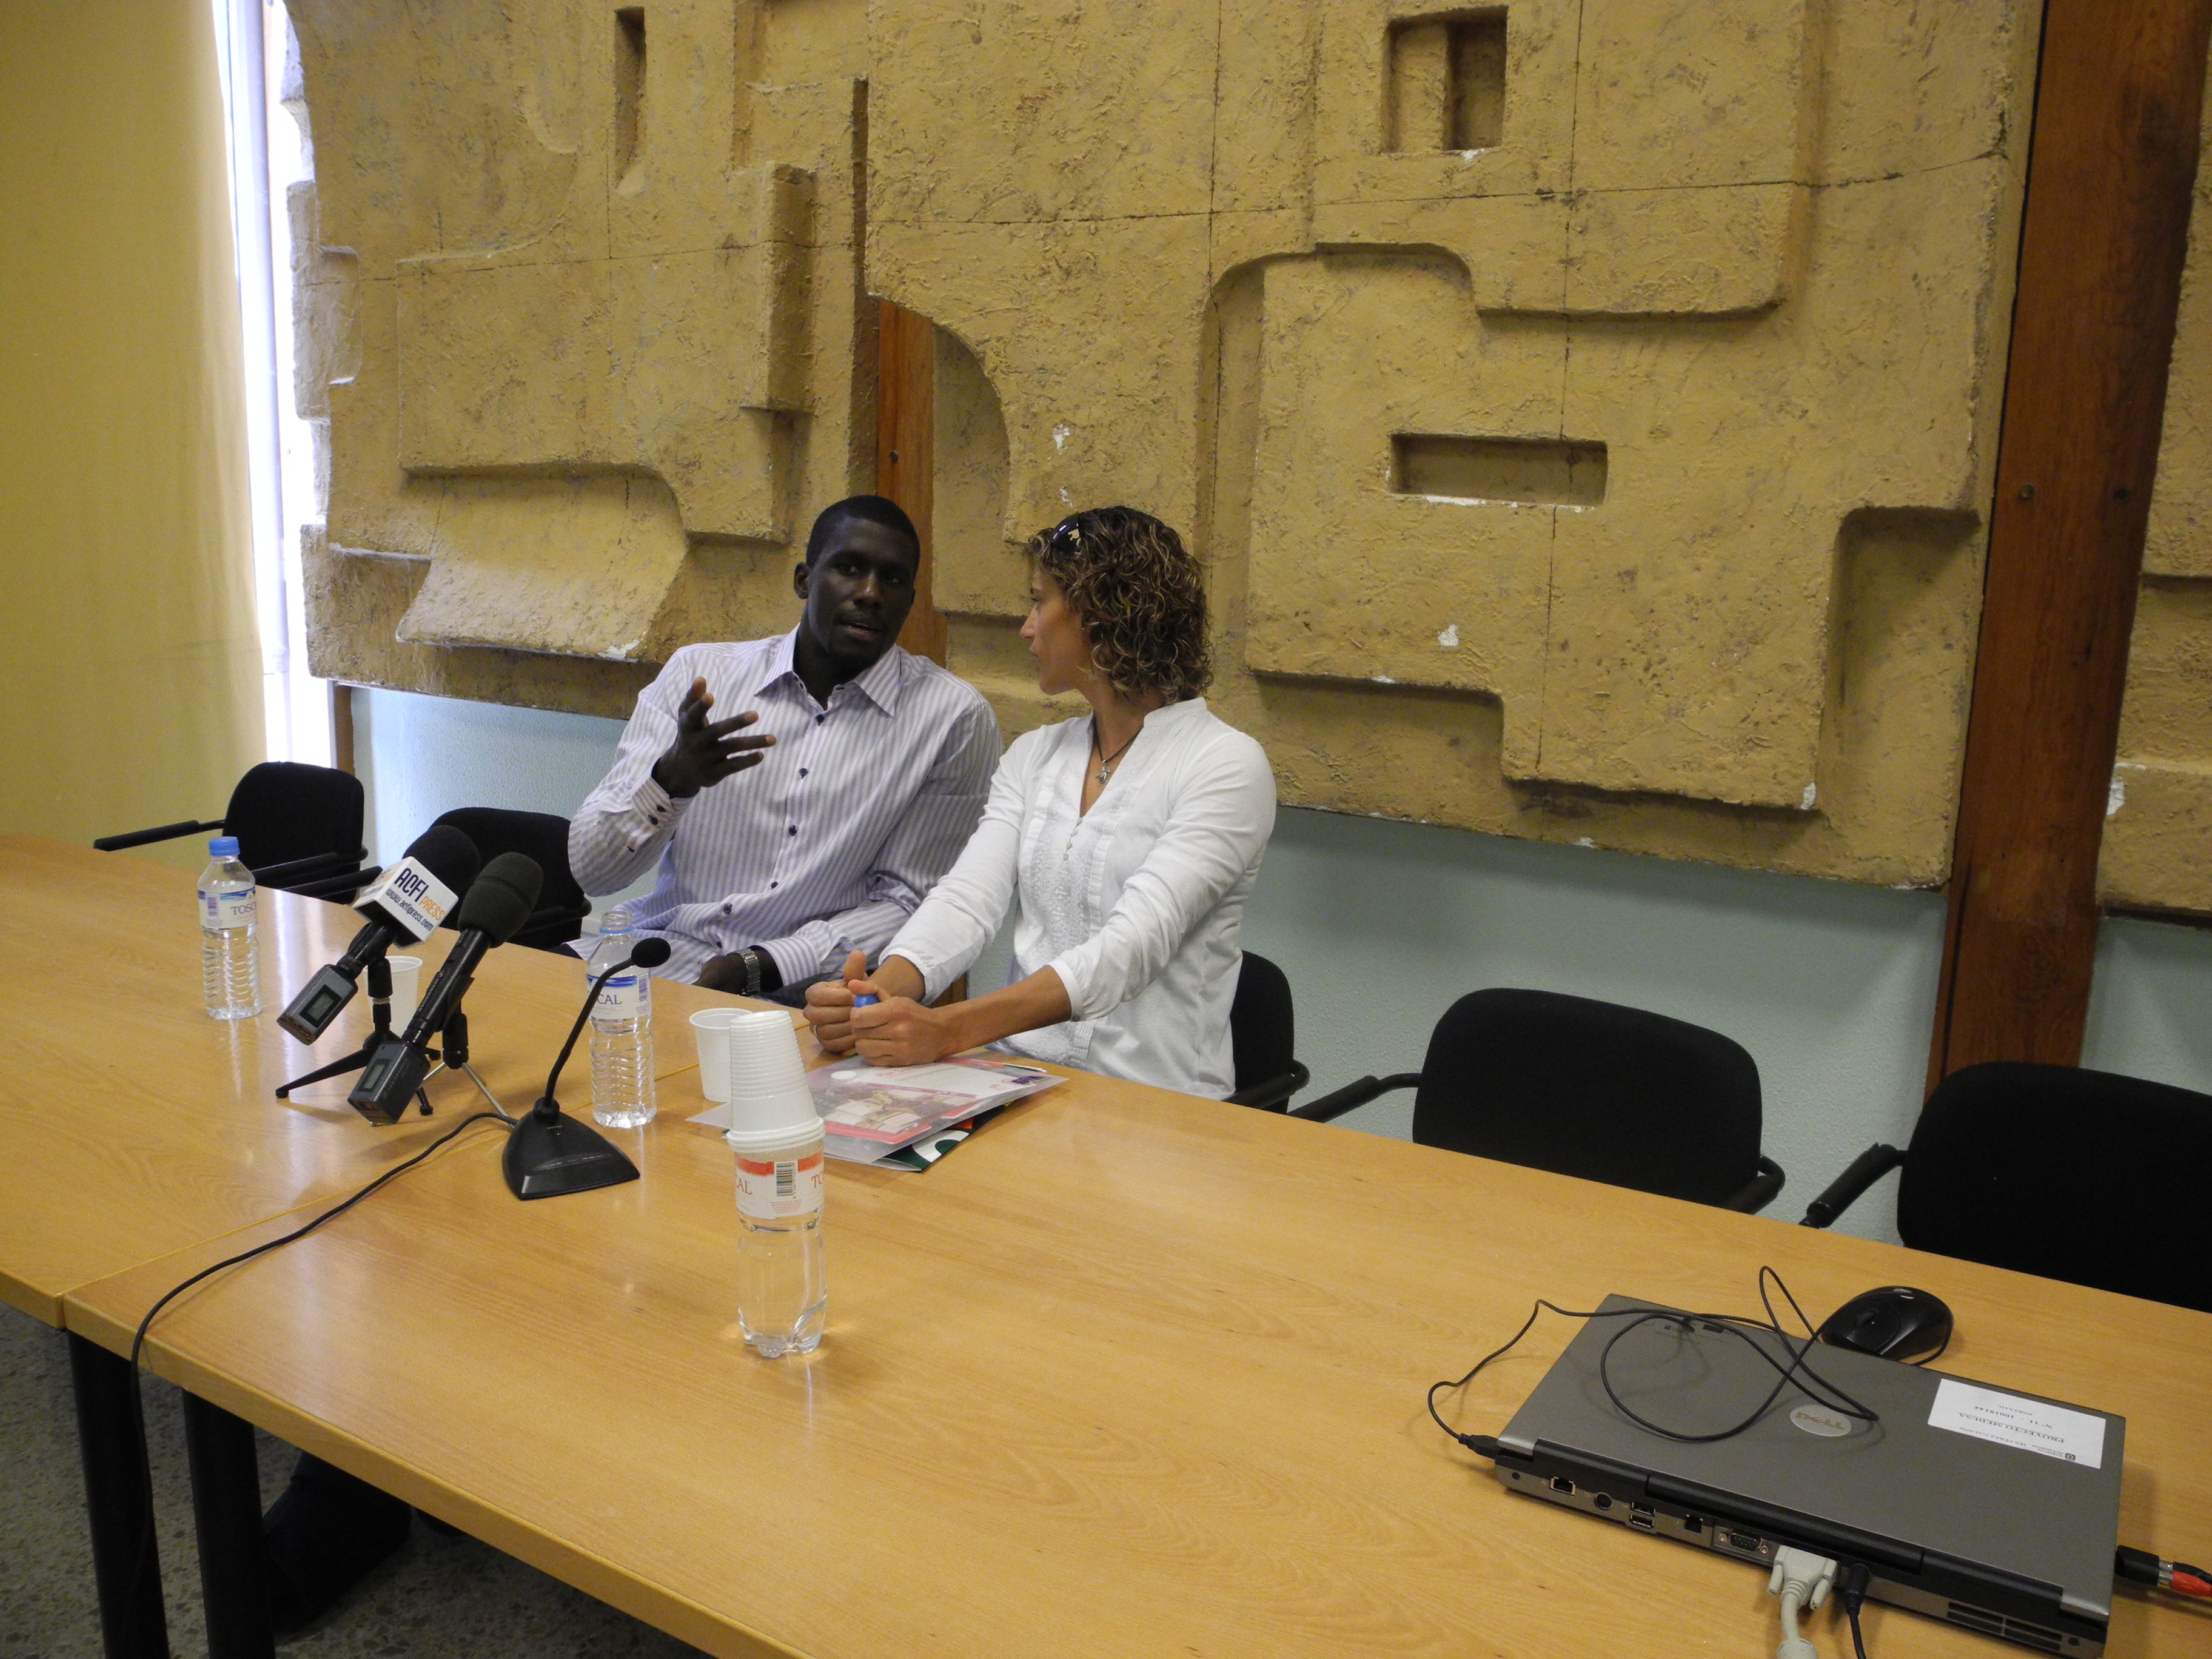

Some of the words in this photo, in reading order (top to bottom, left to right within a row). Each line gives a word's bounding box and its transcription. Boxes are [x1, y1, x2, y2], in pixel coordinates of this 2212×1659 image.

[394, 868, 429, 902] ACFI
[419, 896, 446, 921] PRESS
[386, 888, 434, 931] www.acfipress.com
[1797, 1412, 1844, 1429] DELL
[1959, 1412, 2002, 1427] MEDUSA
[2005, 1424, 2065, 1443] PROYECTO
